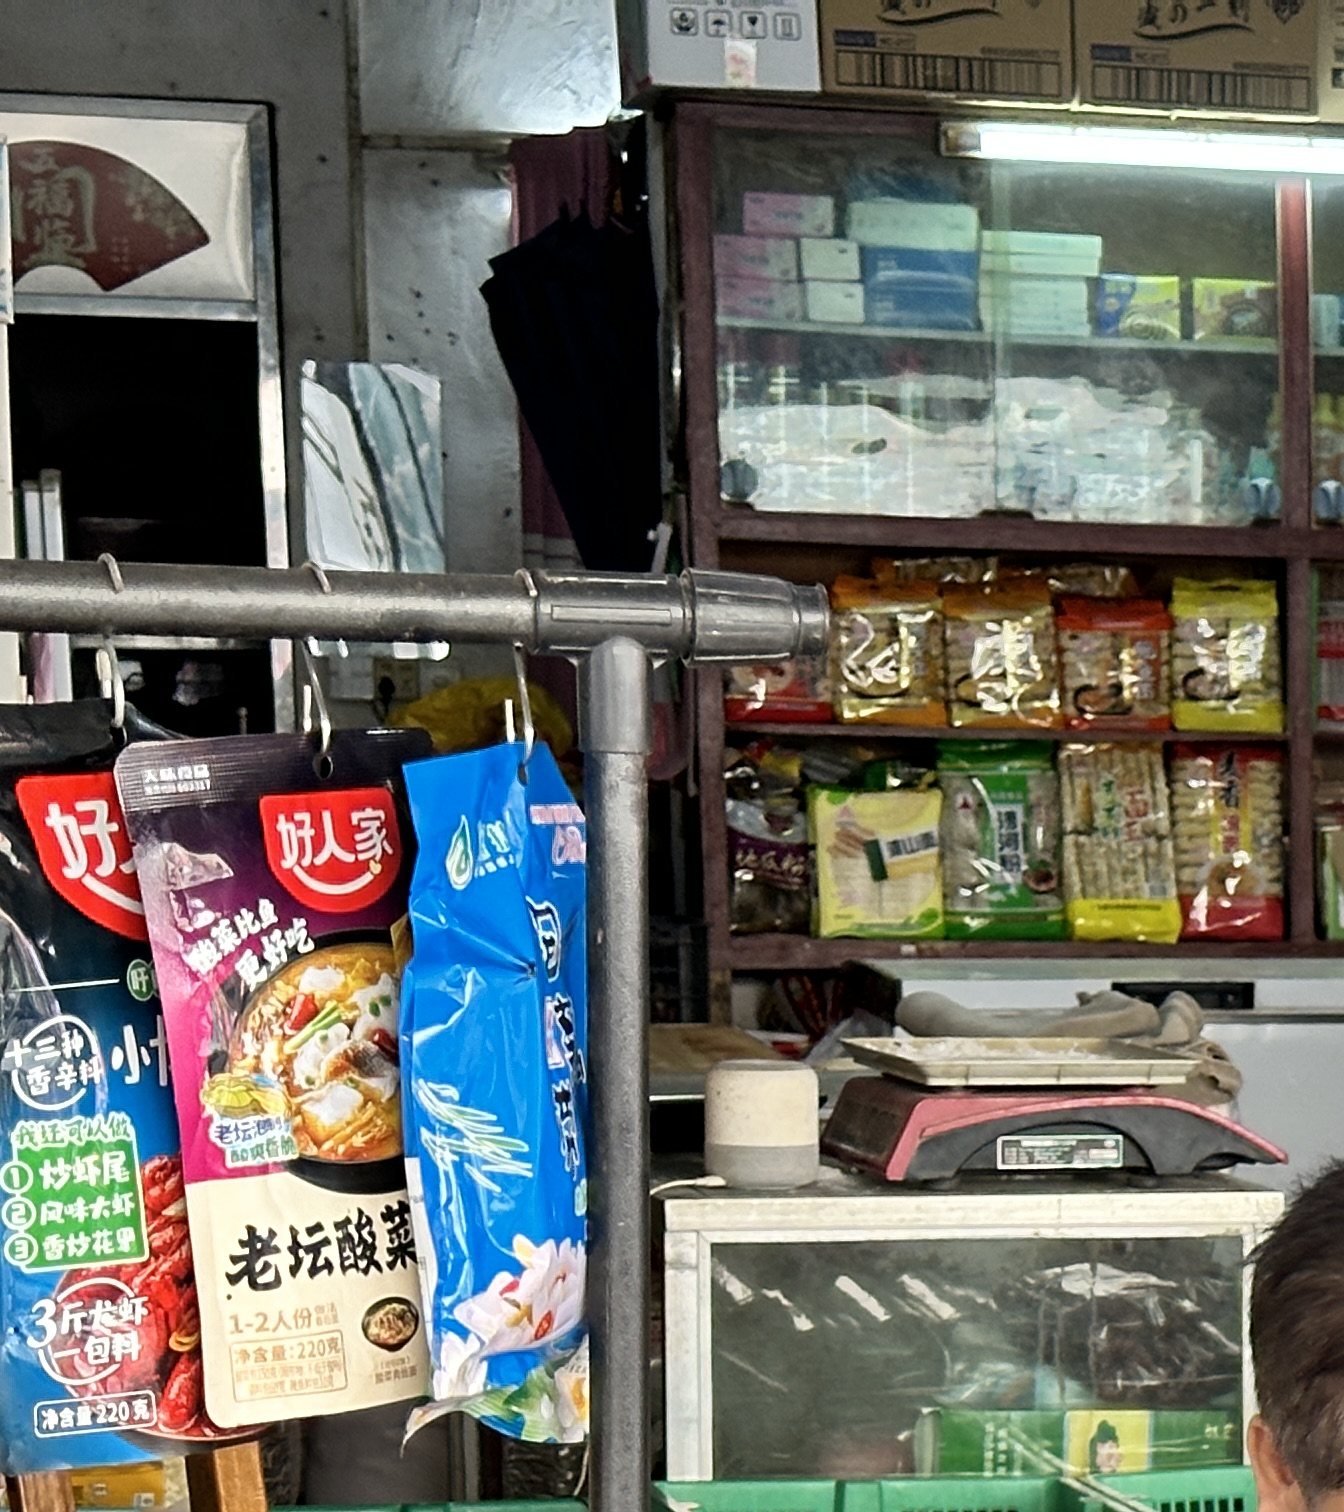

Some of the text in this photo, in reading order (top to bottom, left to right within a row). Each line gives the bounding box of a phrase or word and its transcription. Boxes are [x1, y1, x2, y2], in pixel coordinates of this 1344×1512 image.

[45, 800, 132, 879] 好
[278, 807, 394, 867] 好人家
[234, 918, 315, 991] 更好吃
[4, 1028, 86, 1067] 十三种
[17, 1117, 134, 1147] 我还可以做
[40, 1154, 132, 1190] 炒虾尾
[39, 1198, 137, 1226] 风味大虾
[226, 1200, 420, 1296] 老坛酸菜
[228, 1306, 313, 1336] 1-2人份
[52, 1330, 142, 1364] 一包料
